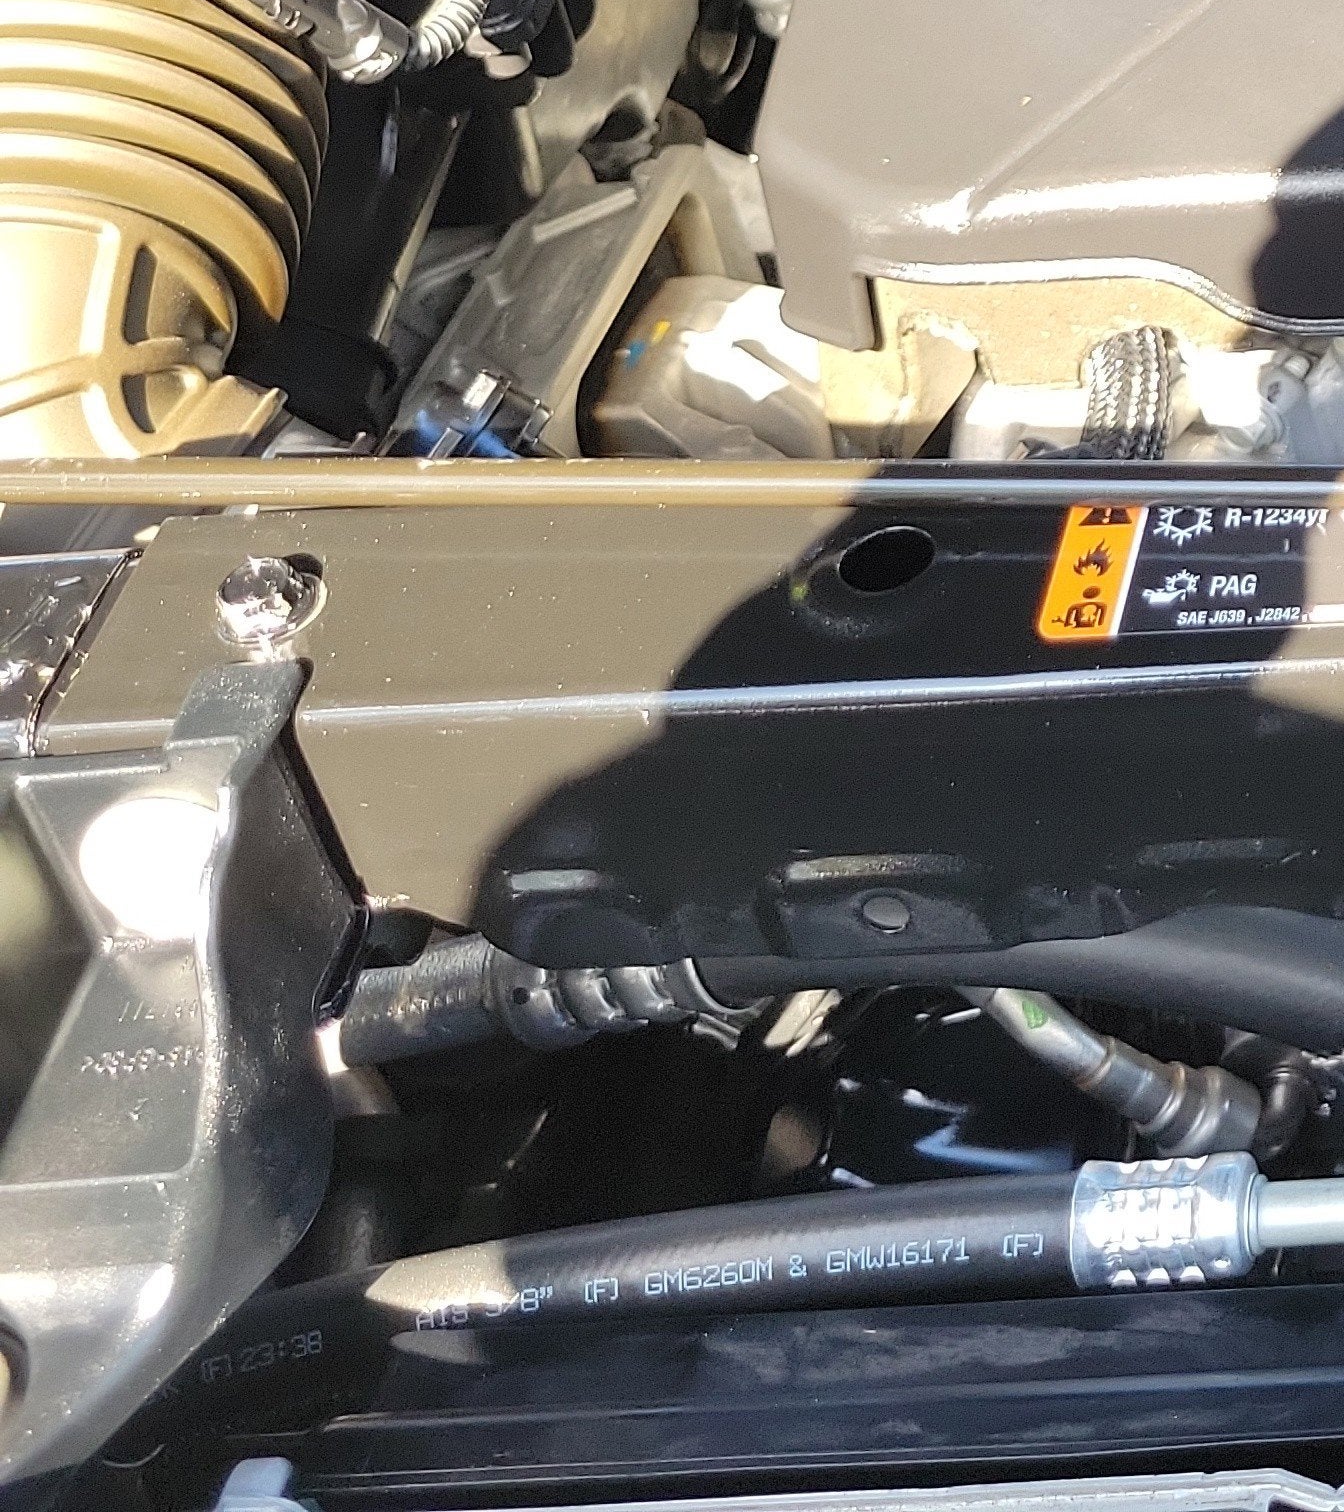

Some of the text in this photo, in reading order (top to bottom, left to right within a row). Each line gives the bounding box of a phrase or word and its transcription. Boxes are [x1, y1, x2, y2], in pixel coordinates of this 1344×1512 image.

[1208, 573, 1258, 598] PAG
[1176, 609, 1208, 626] SAE
[788, 1254, 808, 1278] &
[825, 1237, 970, 1274] GMW16171
